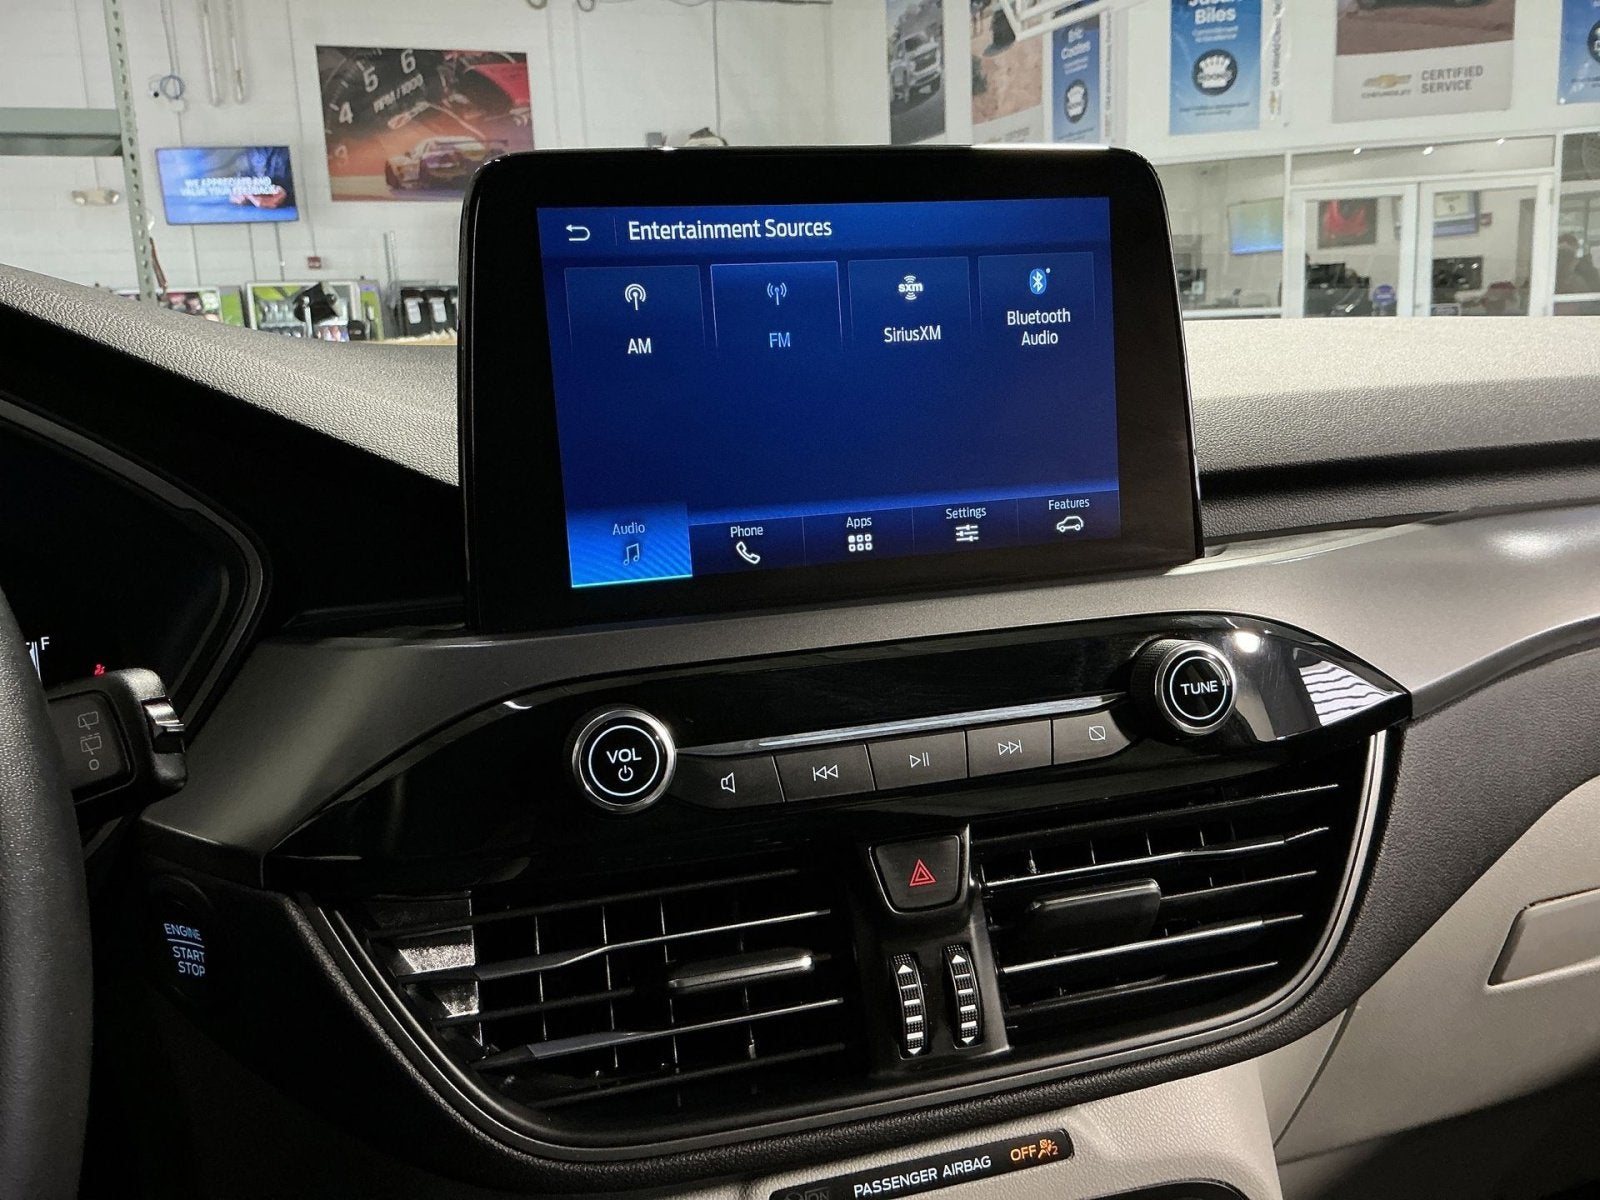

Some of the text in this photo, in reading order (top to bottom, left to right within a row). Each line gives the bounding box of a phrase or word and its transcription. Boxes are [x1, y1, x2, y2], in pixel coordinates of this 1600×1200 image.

[363, 66, 379, 92] 5
[1421, 65, 1484, 81] CERTIFIED
[1421, 79, 1473, 94] SERVICE
[338, 101, 354, 124] 4
[628, 218, 833, 241] Entertainment Sources
[1006, 308, 1071, 326] Bluetooth
[769, 332, 791, 348] FM
[883, 325, 942, 343] SiriusXM
[1021, 330, 1059, 346] Audio
[627, 338, 652, 355] AM
[1047, 497, 1090, 511] Features
[945, 505, 987, 520] Settings
[612, 522, 646, 536] Audio
[846, 516, 872, 530] Apps
[730, 525, 764, 539] Phone
[40, 636, 50, 651] F
[1180, 680, 1219, 696] TUNE
[606, 748, 642, 764] VOL
[163, 922, 203, 941] ENGINE
[172, 945, 205, 963] START
[178, 961, 206, 977] STOP
[1010, 1144, 1037, 1161] OFF
[853, 1155, 992, 1198] PASSENGER AIRBAG
